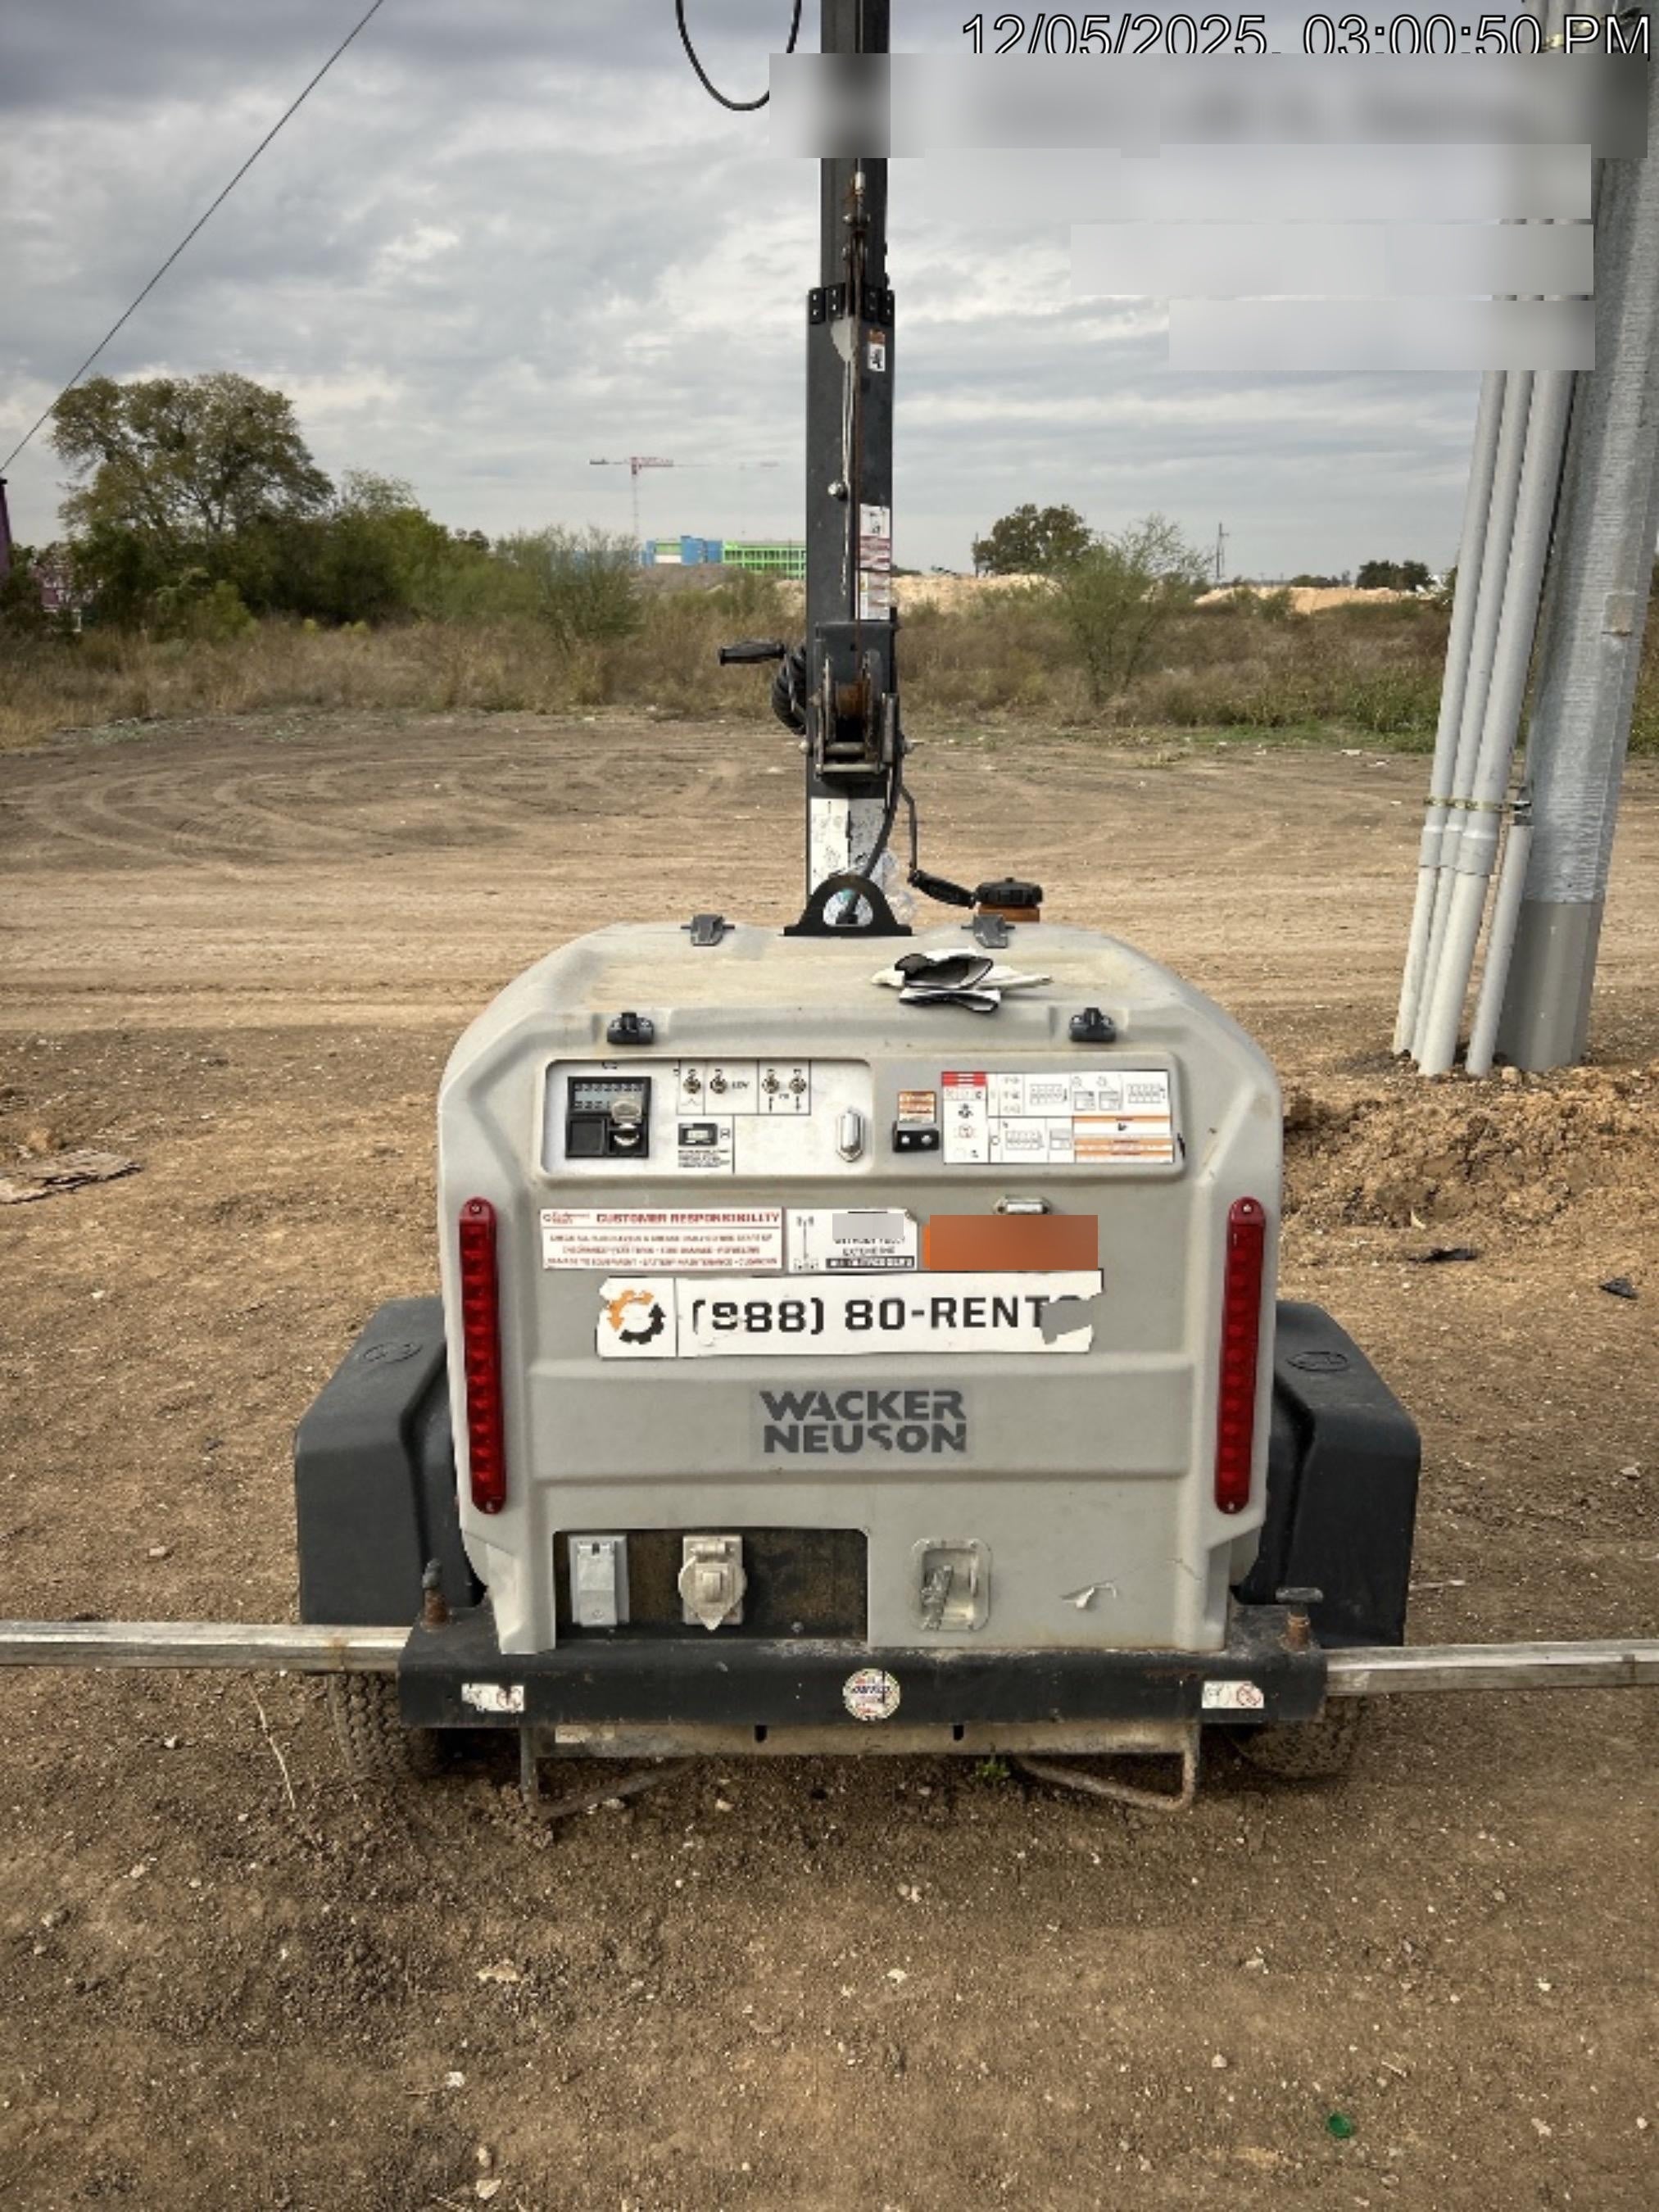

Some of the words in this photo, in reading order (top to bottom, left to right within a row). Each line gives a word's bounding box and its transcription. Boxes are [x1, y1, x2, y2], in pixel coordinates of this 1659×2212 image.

[844, 1295, 1081, 1332] 80-RENT
[759, 1390, 967, 1421] WACKER
[764, 1424, 968, 1454] NEUSON
